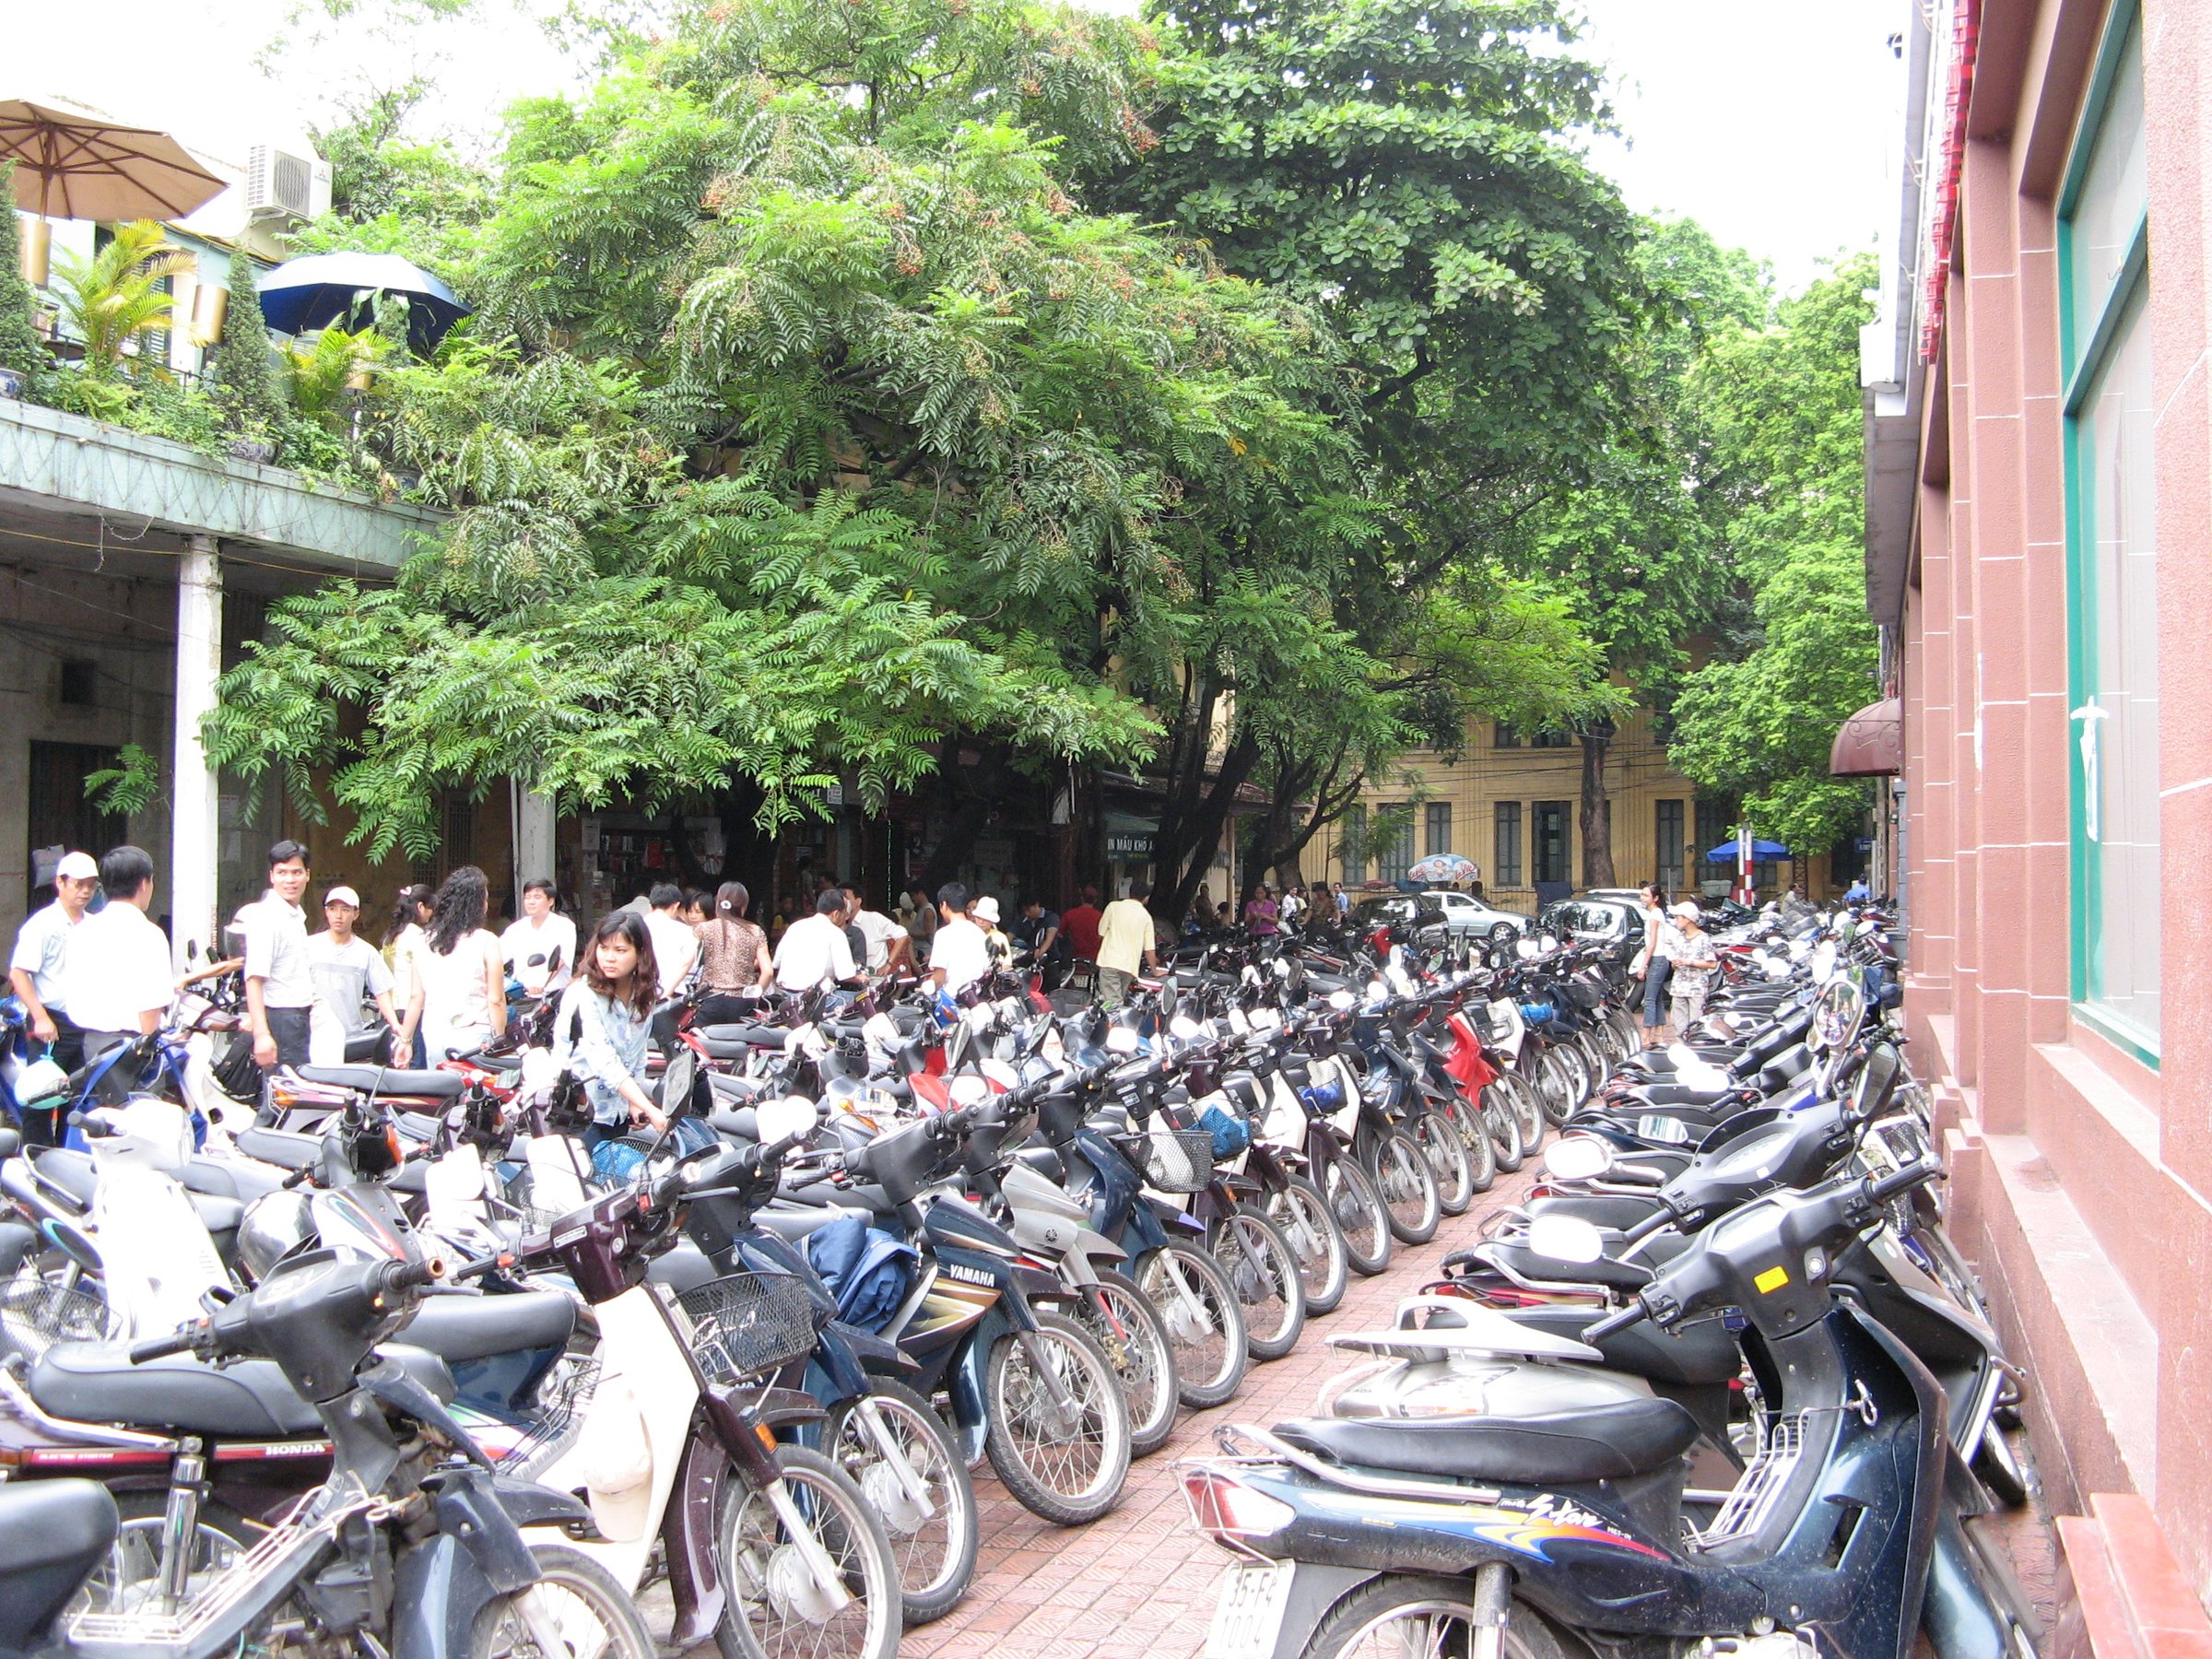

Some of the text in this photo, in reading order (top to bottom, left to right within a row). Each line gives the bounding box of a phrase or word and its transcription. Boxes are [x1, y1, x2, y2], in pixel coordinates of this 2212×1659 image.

[949, 1264, 995, 1288] YAMAHA
[265, 1443, 325, 1455] HONDA
[1522, 1493, 1603, 1527] Star
